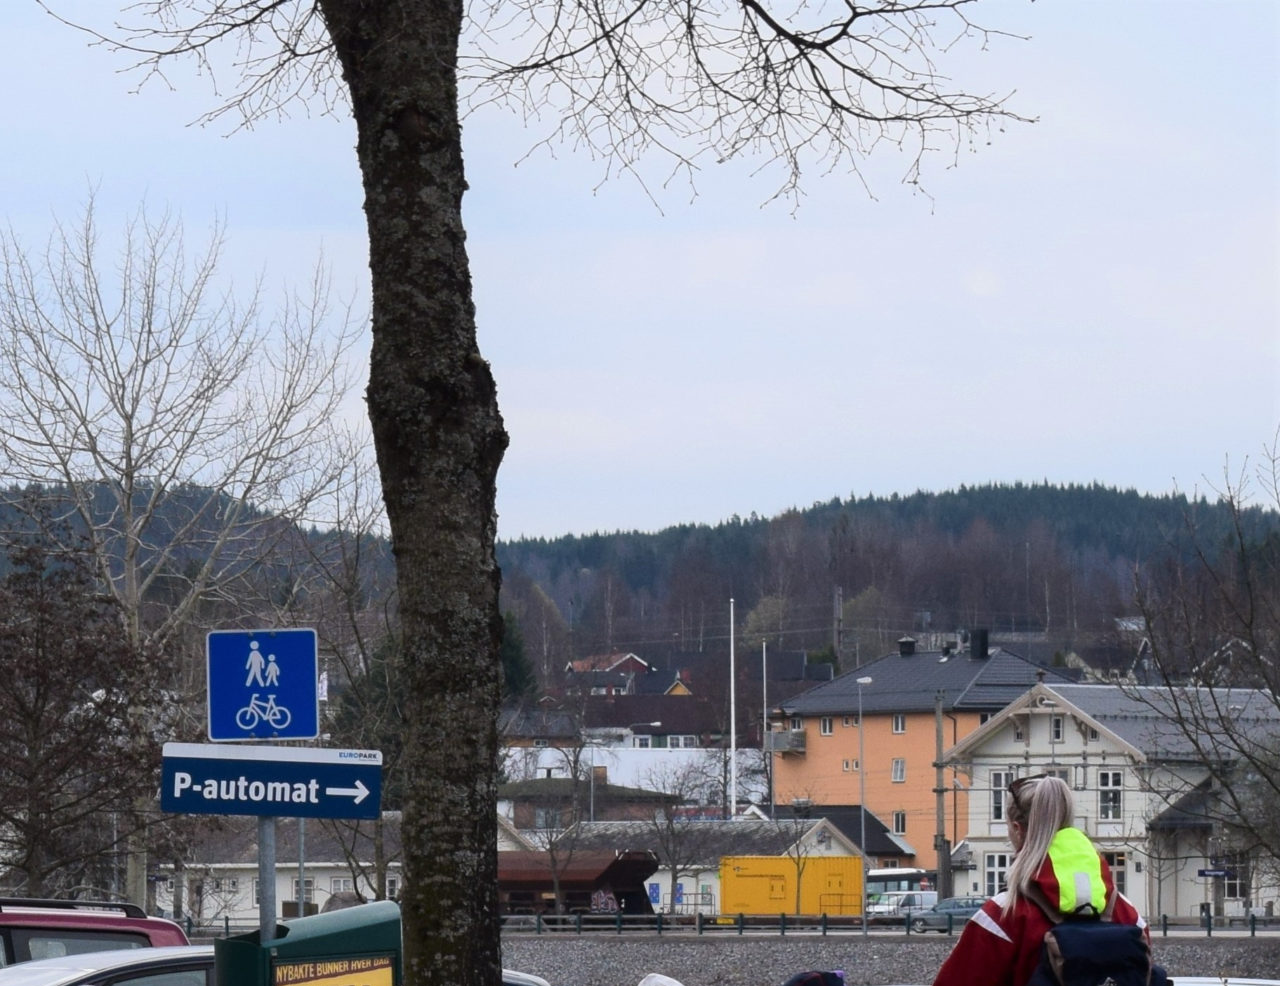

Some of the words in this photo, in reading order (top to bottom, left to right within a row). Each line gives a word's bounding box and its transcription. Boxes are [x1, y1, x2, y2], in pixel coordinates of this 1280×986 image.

[339, 751, 377, 759] EUROPARK
[173, 772, 319, 803] P-automat
[276, 963, 314, 982] NYBAKTE
[317, 960, 349, 976] BUNNER
